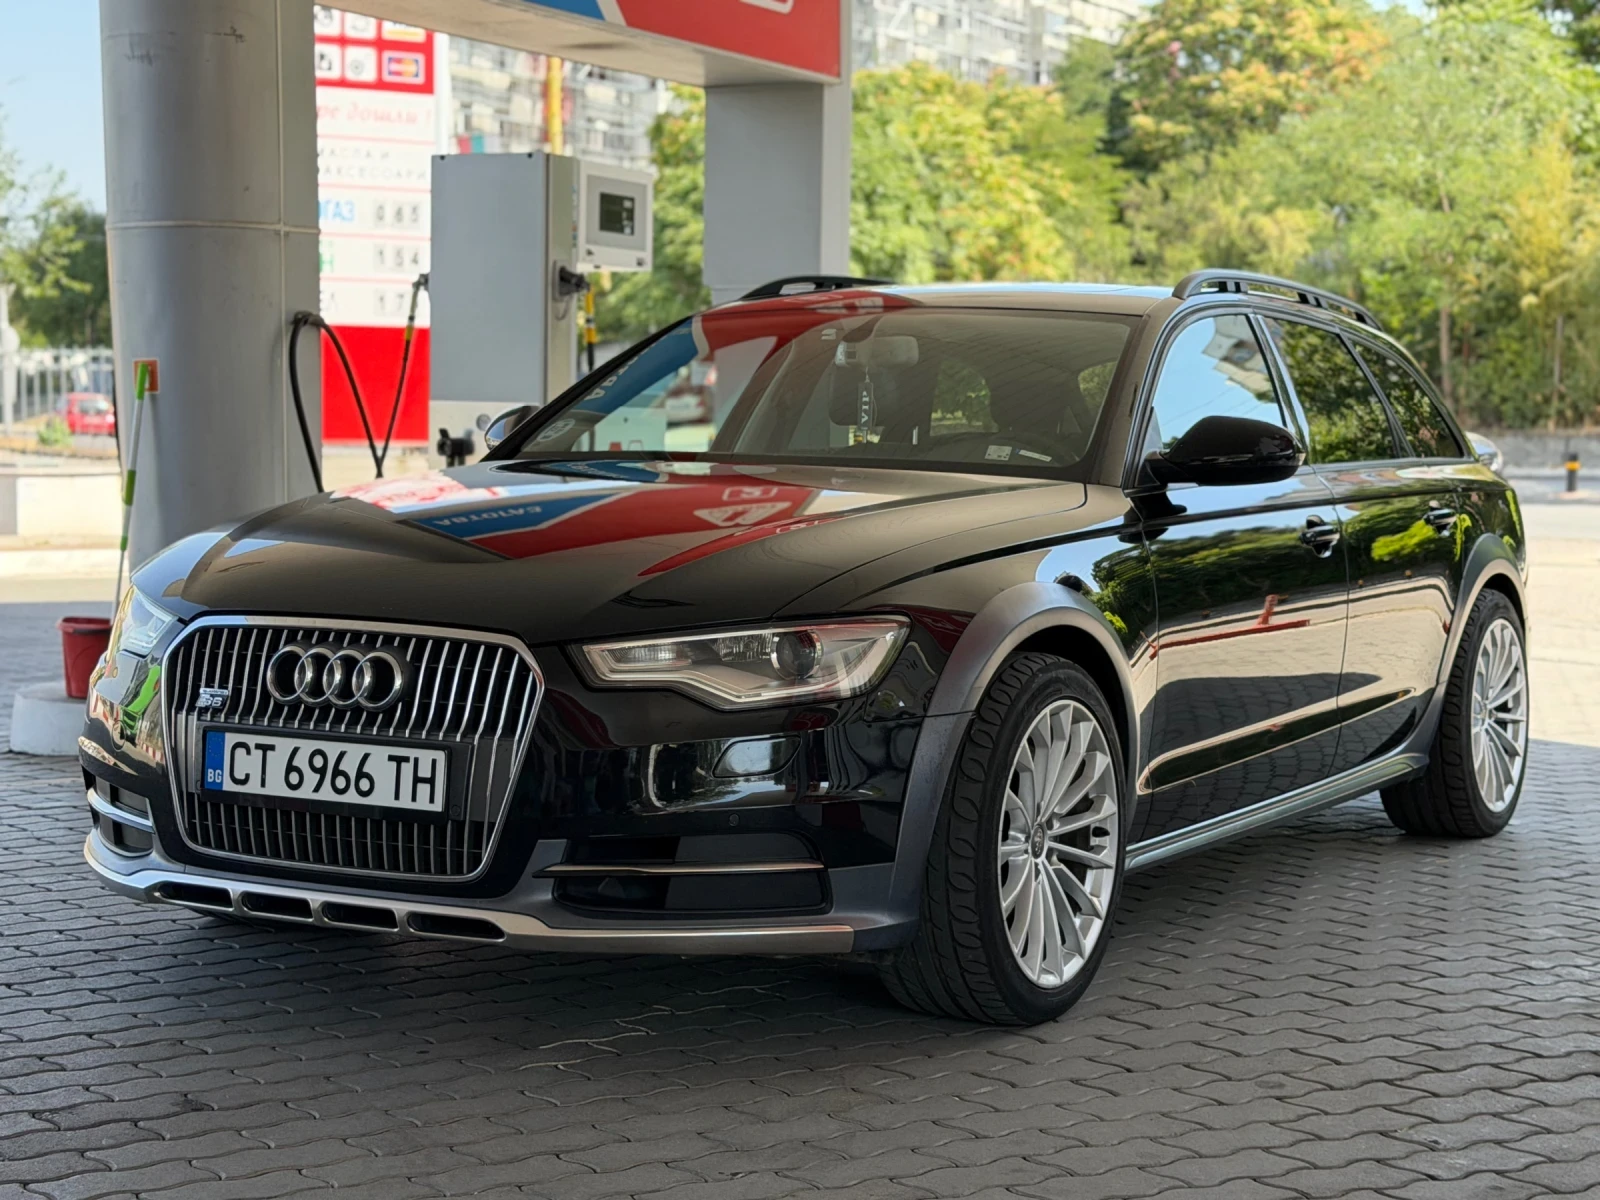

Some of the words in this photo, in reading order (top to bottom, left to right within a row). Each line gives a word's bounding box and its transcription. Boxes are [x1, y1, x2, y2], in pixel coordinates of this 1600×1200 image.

[861, 391, 869, 424] VIP
[207, 768, 222, 783] BG
[229, 741, 276, 788] CT
[284, 746, 375, 797] 6966
[387, 754, 438, 804] TH
